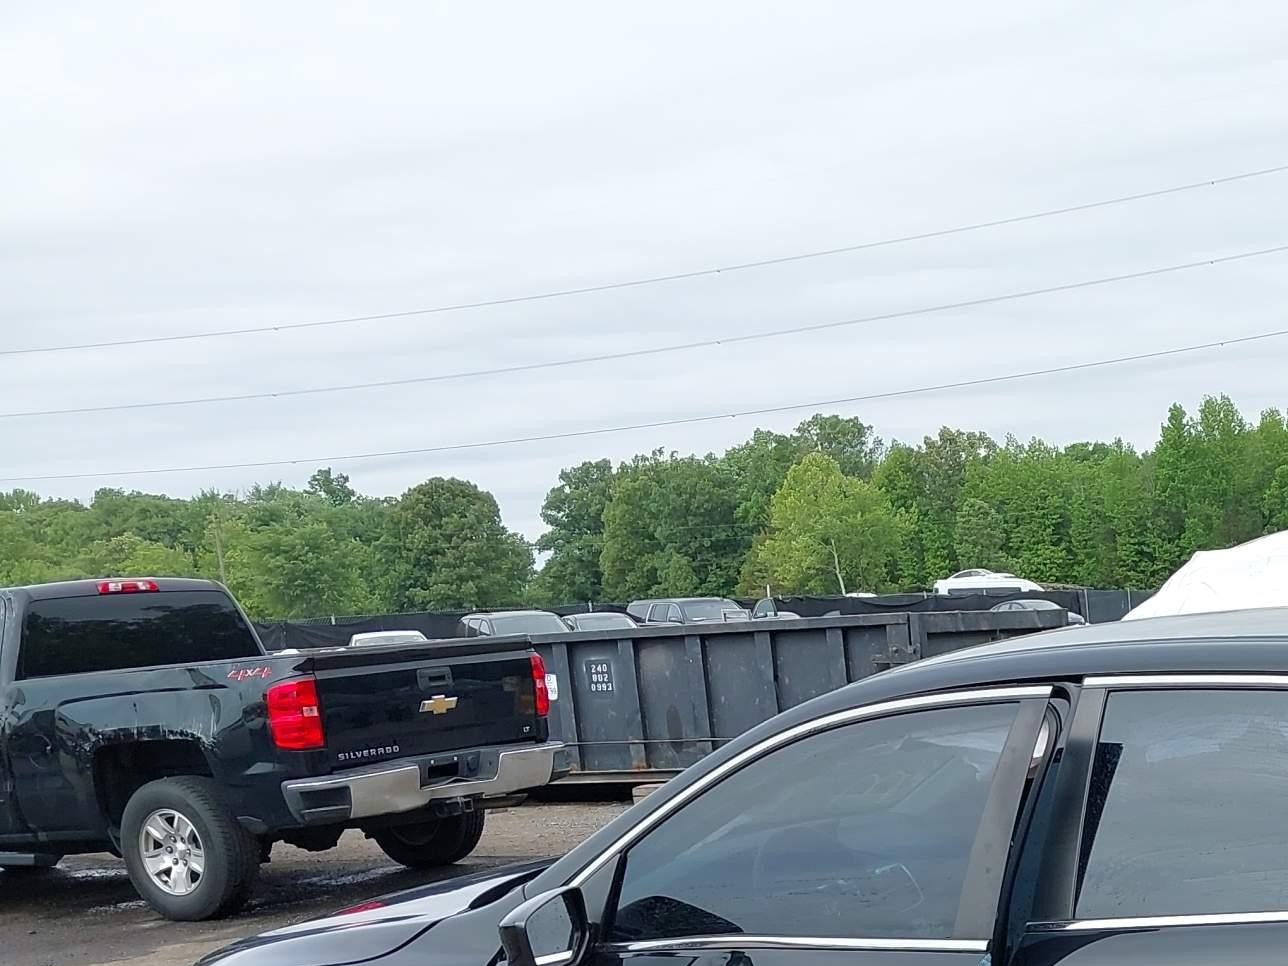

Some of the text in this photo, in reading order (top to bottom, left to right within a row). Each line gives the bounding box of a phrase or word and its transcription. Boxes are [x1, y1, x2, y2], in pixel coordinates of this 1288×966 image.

[591, 663, 608, 673] 240
[592, 673, 609, 682] 802
[338, 745, 400, 761] SILVERADO
